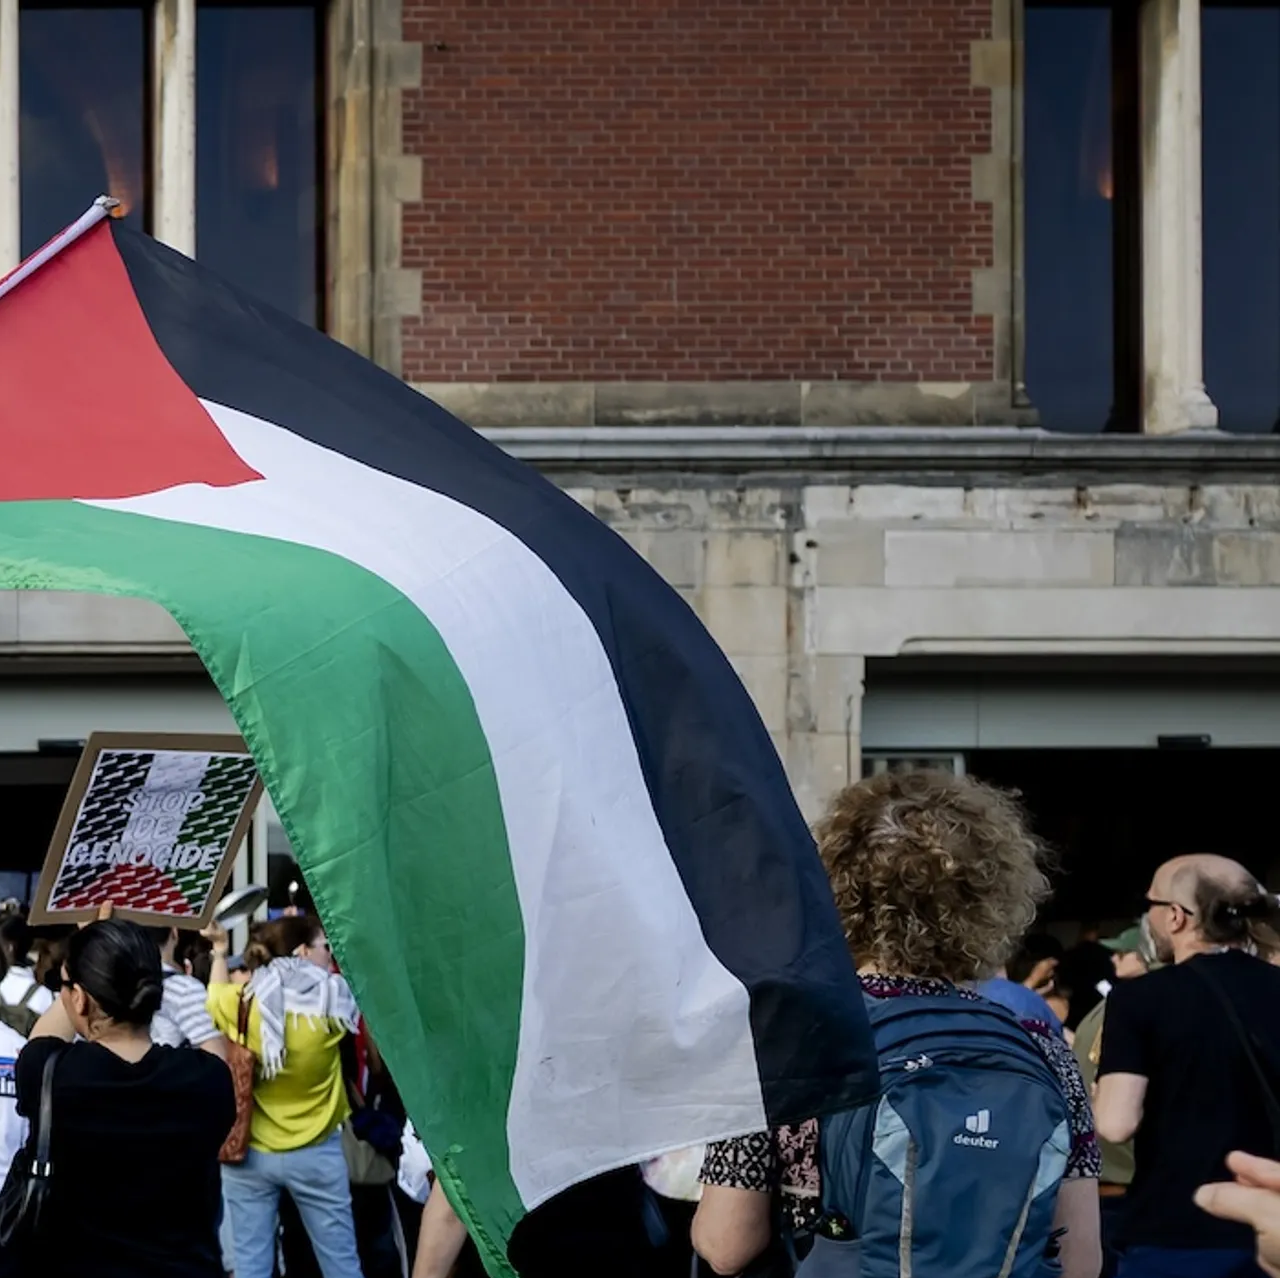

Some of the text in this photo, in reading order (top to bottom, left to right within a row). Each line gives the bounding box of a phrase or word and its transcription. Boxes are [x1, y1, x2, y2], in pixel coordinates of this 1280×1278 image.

[122, 790, 207, 814] STOP
[131, 815, 175, 841] DE
[69, 842, 216, 871] GENOCIDE
[953, 1133, 1000, 1149] deuter
